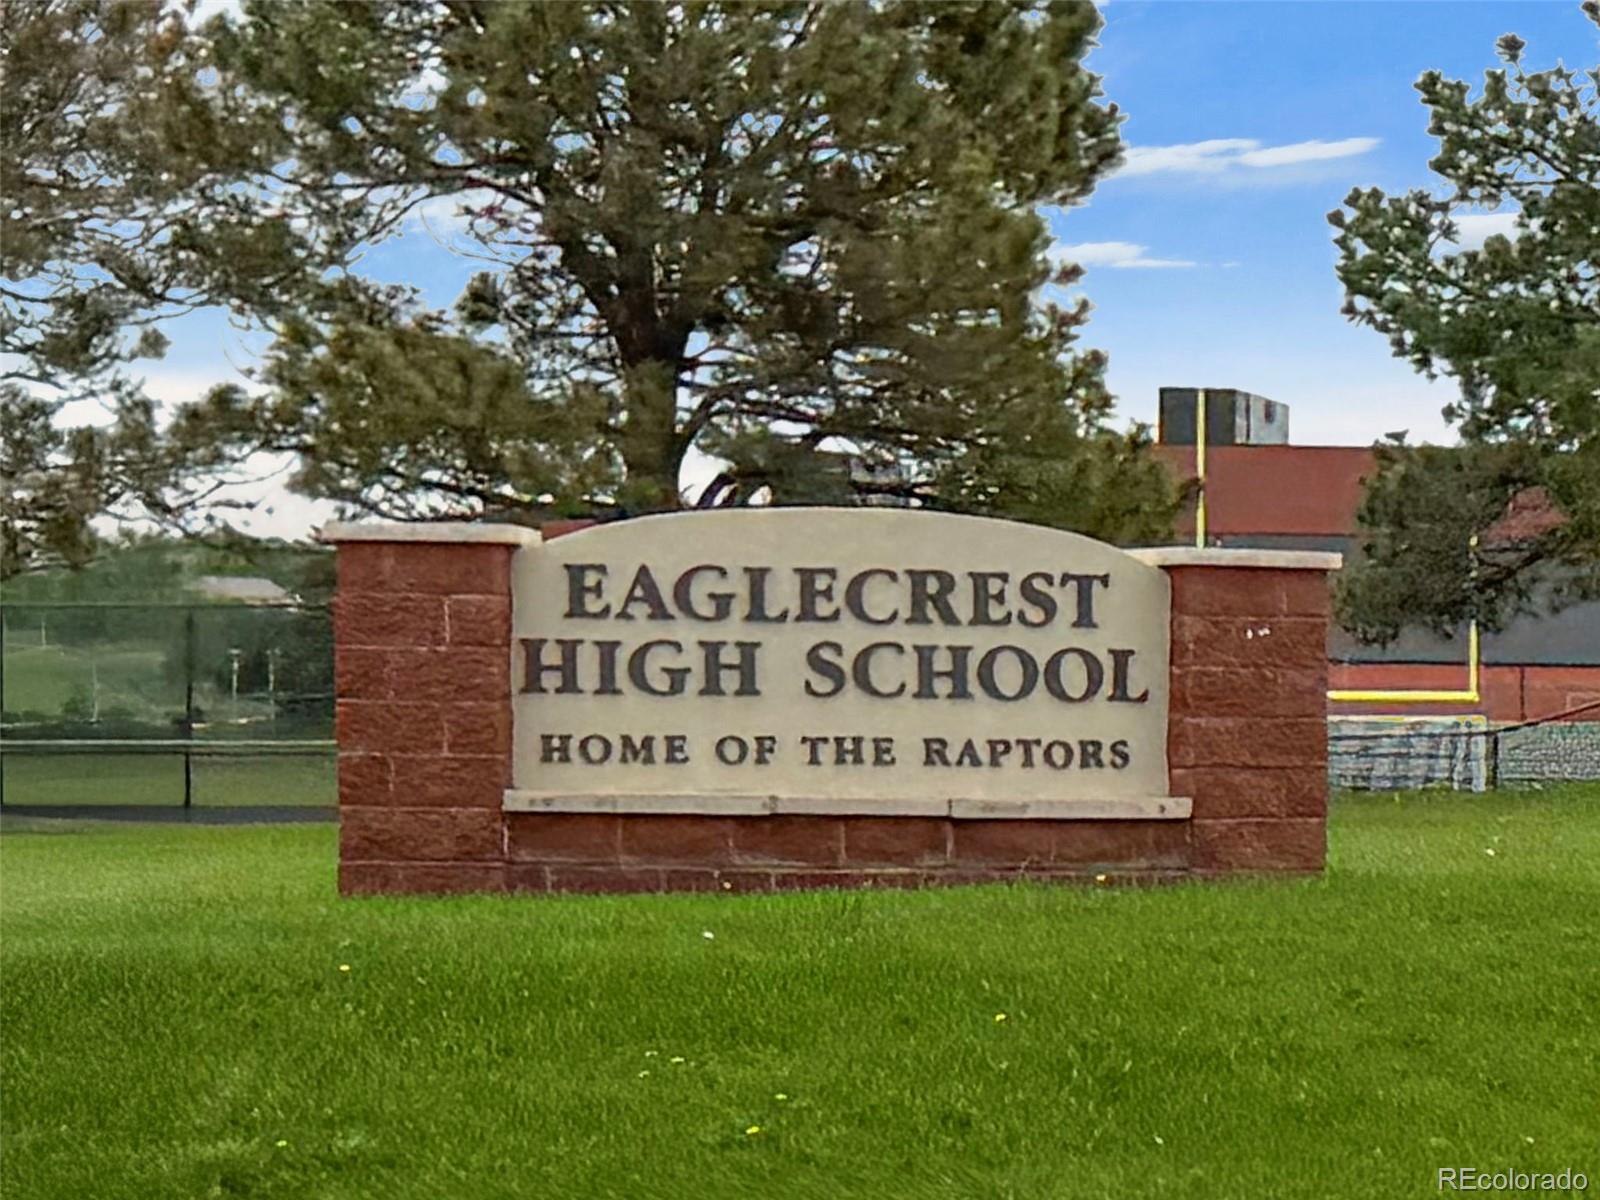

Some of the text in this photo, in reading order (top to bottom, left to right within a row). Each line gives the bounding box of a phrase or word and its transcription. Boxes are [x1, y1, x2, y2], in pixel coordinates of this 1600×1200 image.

[563, 562, 1110, 630] EAGLECREST
[519, 637, 1149, 706] HIGH SCHOOL
[539, 733, 1131, 771] HOME OF THE RAPTORS
